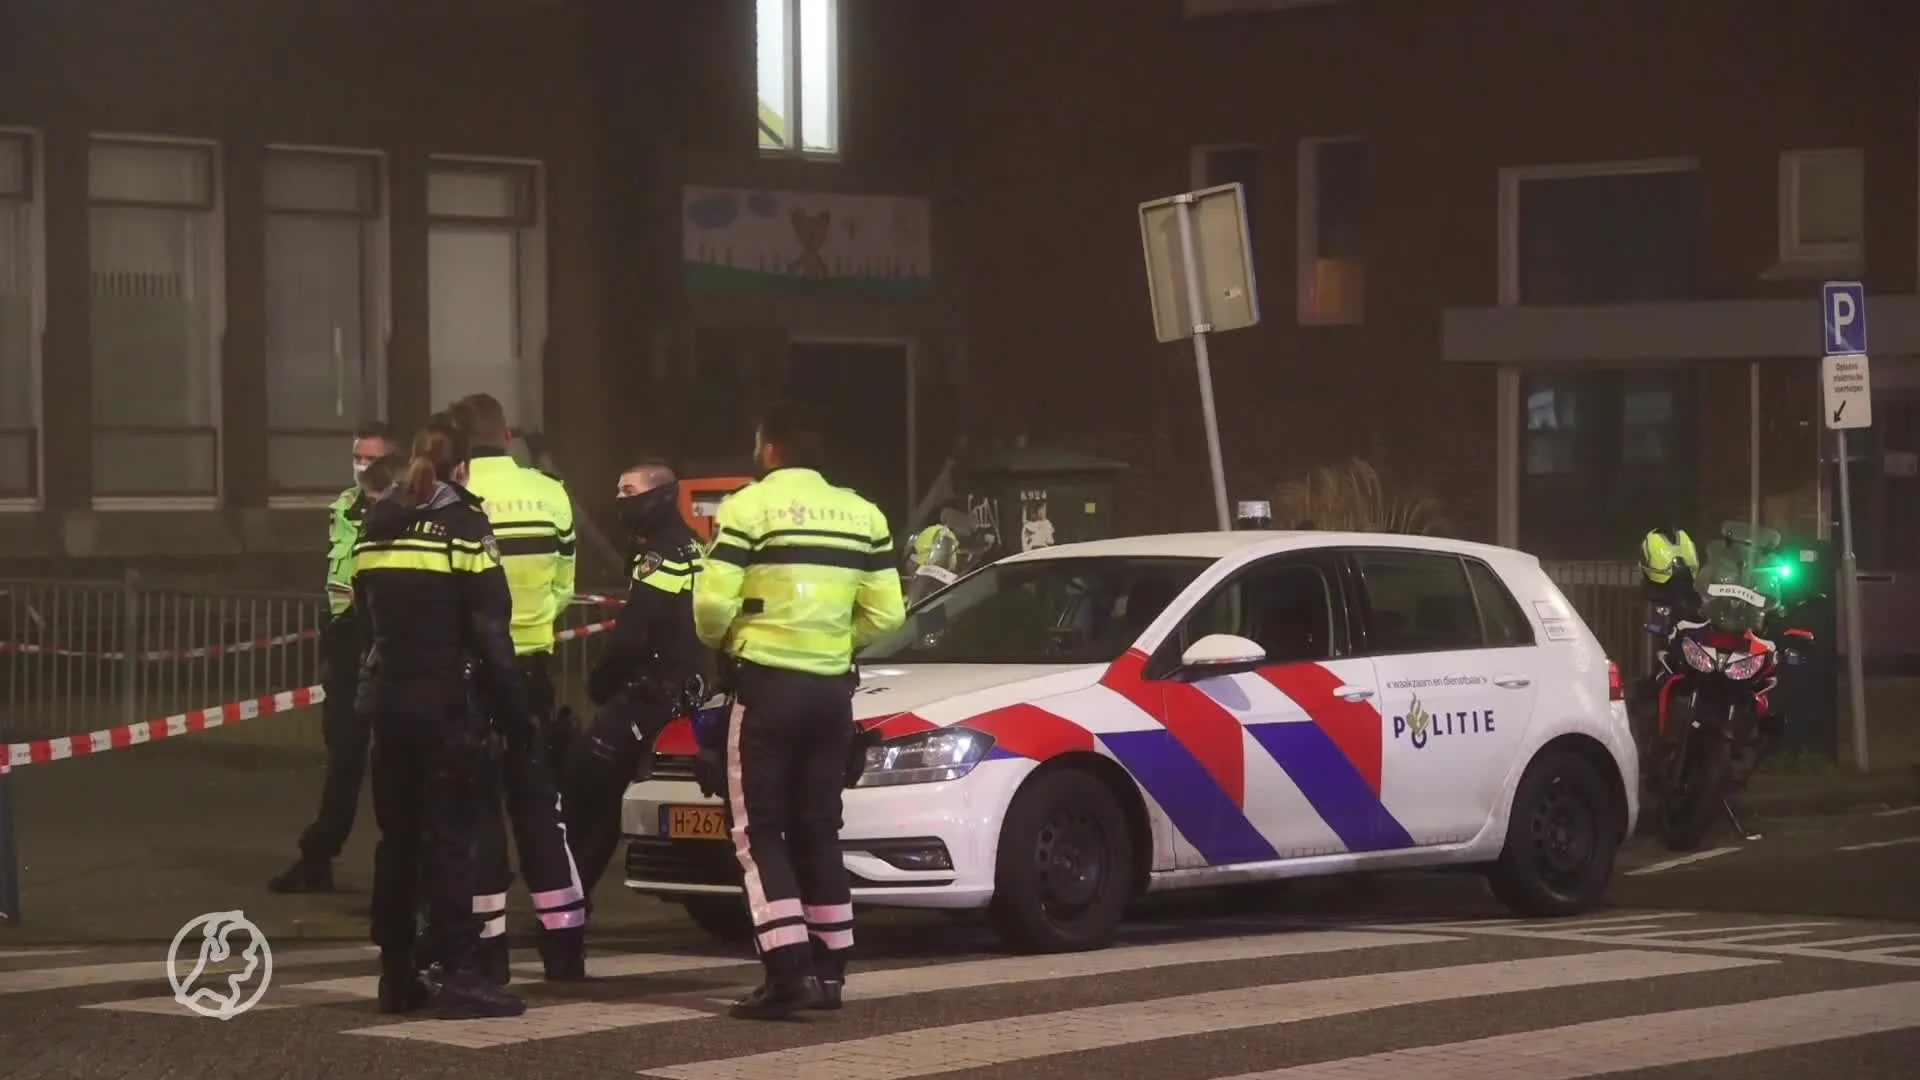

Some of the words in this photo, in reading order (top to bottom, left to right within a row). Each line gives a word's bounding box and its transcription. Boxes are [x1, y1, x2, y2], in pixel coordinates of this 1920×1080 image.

[1832, 292, 1856, 345] P
[1719, 587, 1756, 600] POLITIE
[1392, 709, 1496, 750] POLITIE
[674, 810, 725, 834] H-267
